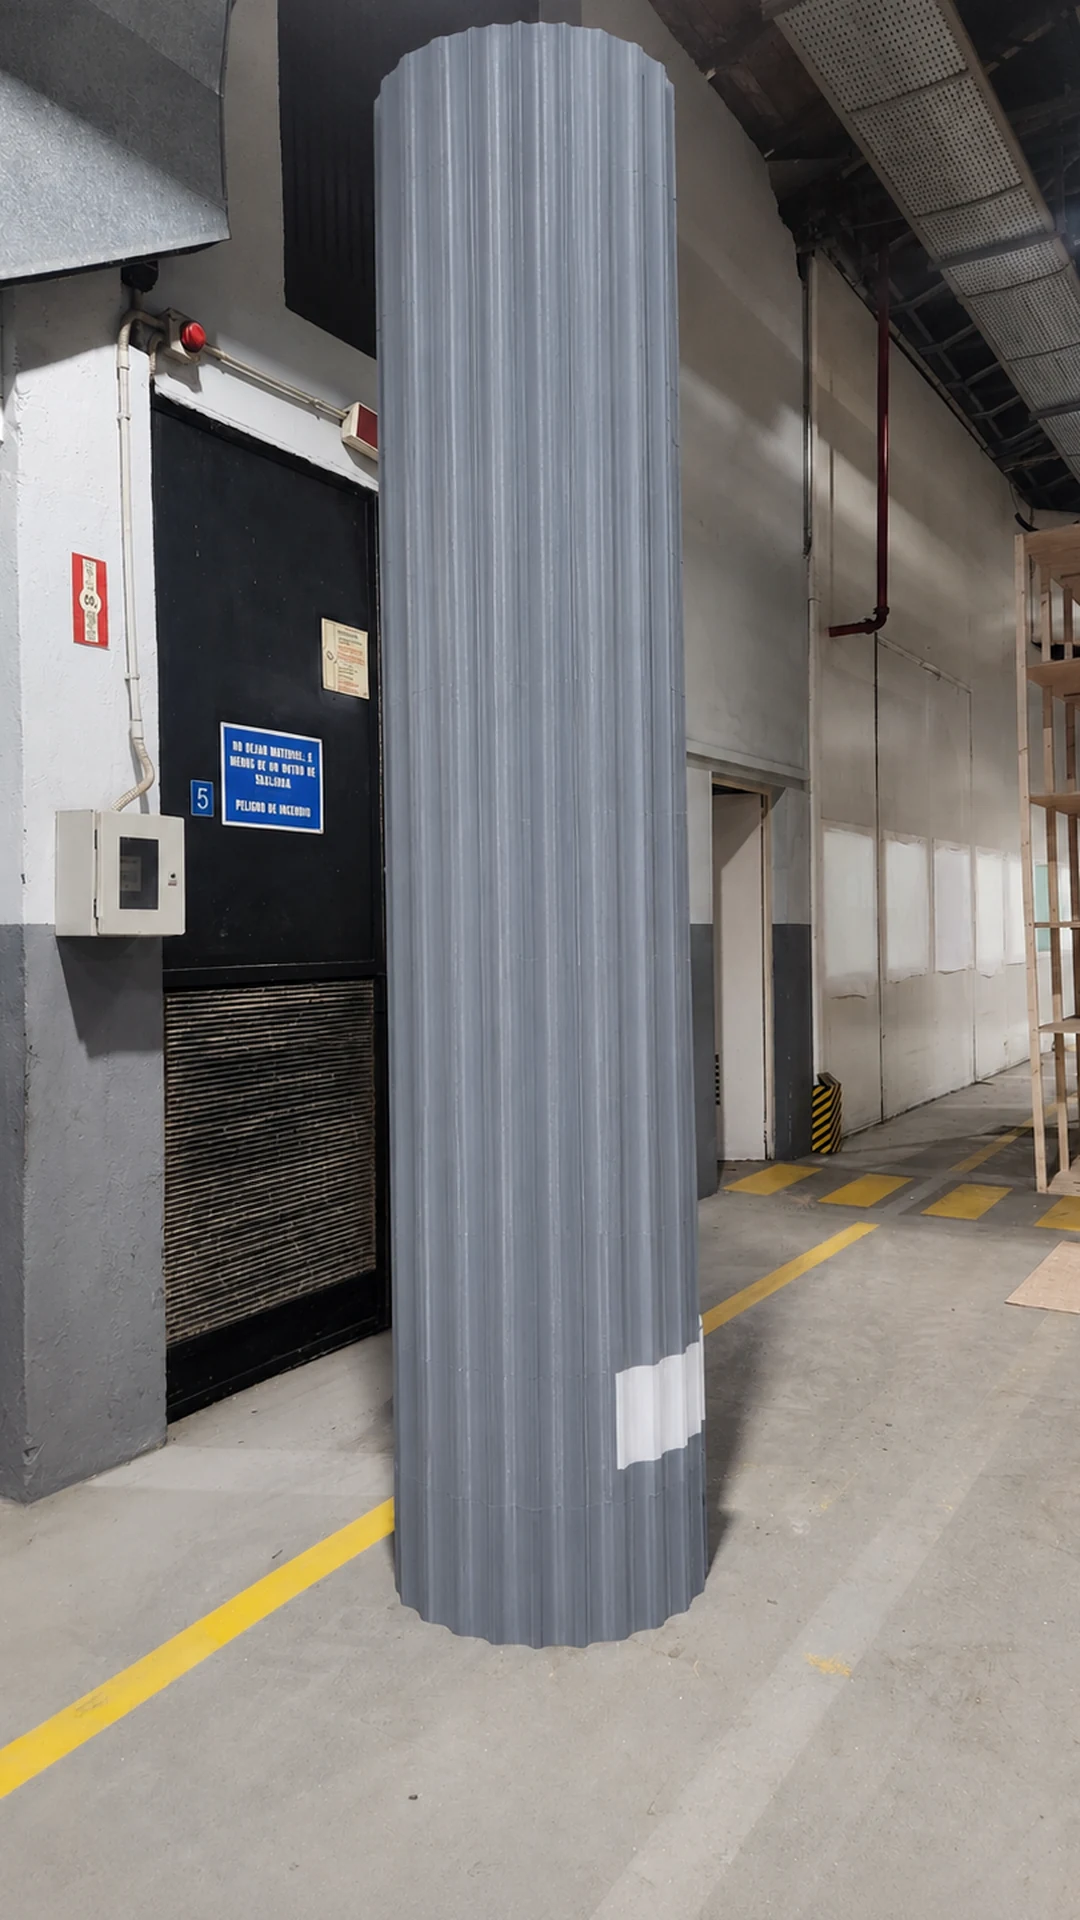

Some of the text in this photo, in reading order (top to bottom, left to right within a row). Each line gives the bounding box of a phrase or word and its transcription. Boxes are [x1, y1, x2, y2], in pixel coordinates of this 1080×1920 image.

[307, 767, 316, 778] DE
[197, 787, 208, 809] 5
[236, 799, 265, 813] PELIGRO
[268, 803, 276, 814] DE
